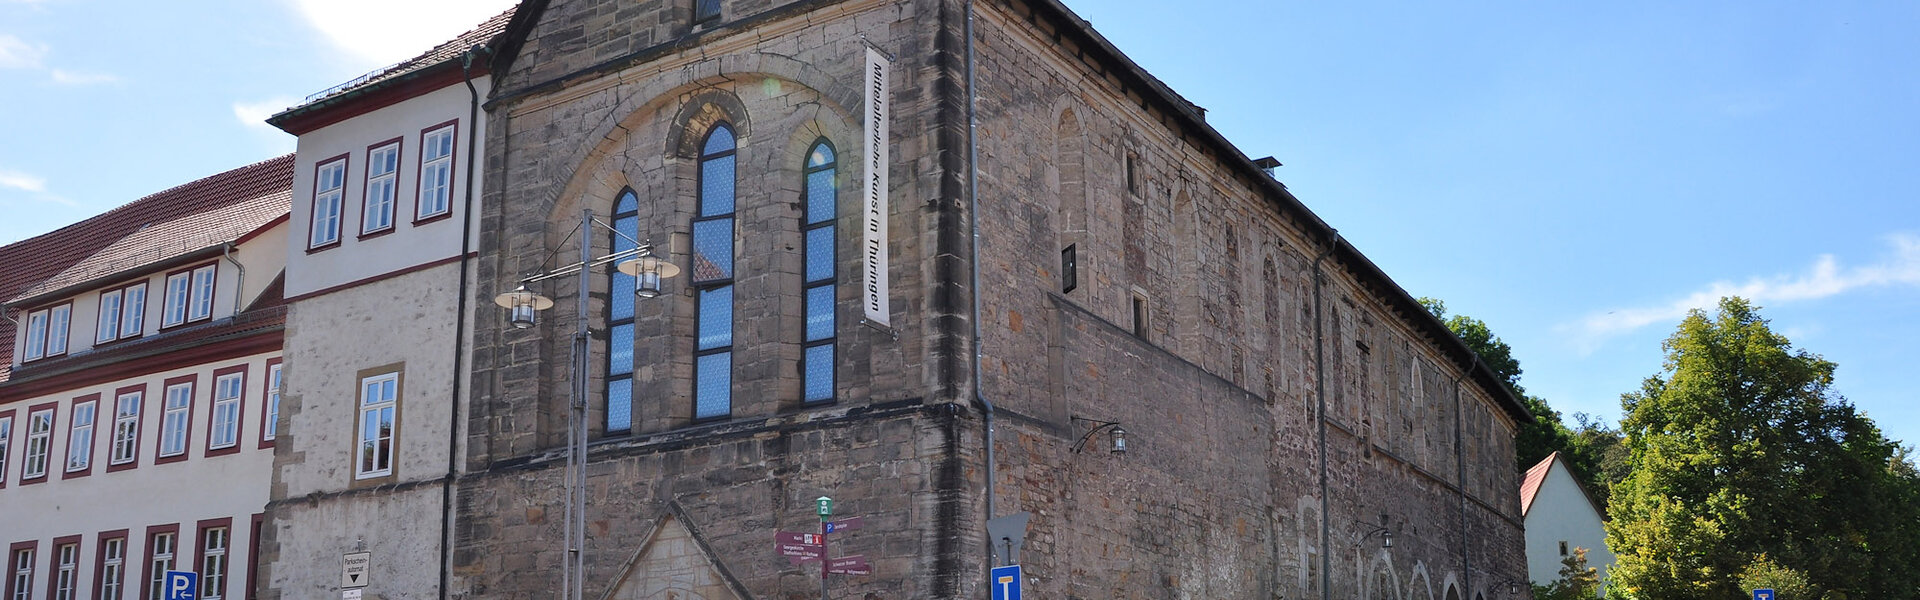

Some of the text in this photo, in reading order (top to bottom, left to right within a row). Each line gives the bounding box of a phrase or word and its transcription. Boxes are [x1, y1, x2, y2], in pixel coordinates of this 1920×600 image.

[869, 62, 882, 312] Mittelalterliche Kunst in Thüringen
[171, 574, 190, 599] P
